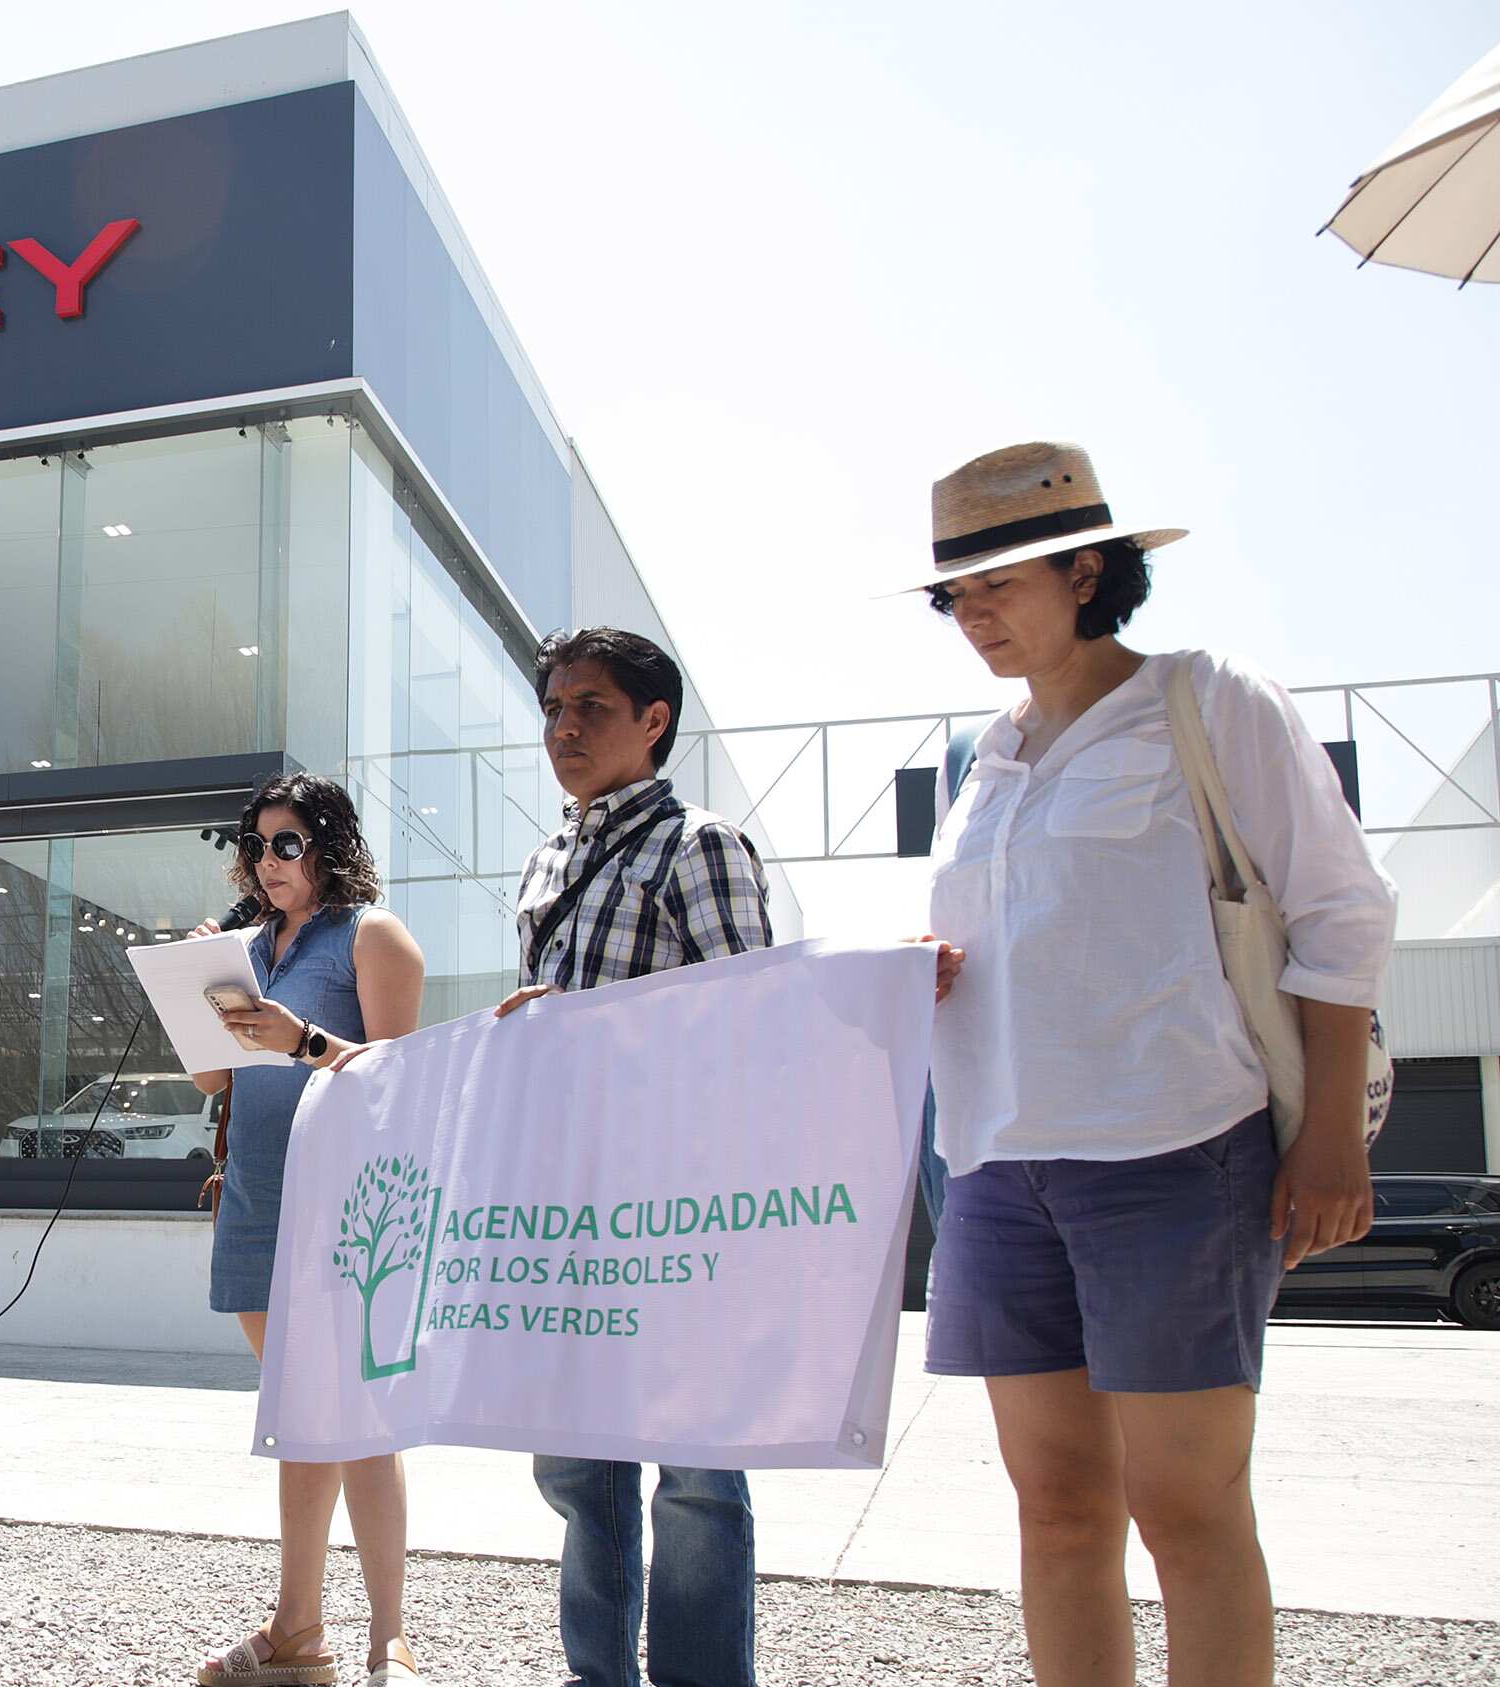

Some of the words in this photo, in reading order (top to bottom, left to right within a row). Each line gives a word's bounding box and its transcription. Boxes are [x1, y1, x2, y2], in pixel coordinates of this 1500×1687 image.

[441, 1204, 602, 1244] AGENDA
[609, 1183, 858, 1241] CIUDADANA
[435, 1255, 482, 1287] POR
[490, 1256, 550, 1286] LOS
[556, 1250, 693, 1288] ÁRBOLES
[701, 1252, 722, 1283] Y
[426, 1298, 514, 1332] ÁREAS
[520, 1305, 641, 1338] VERDES
